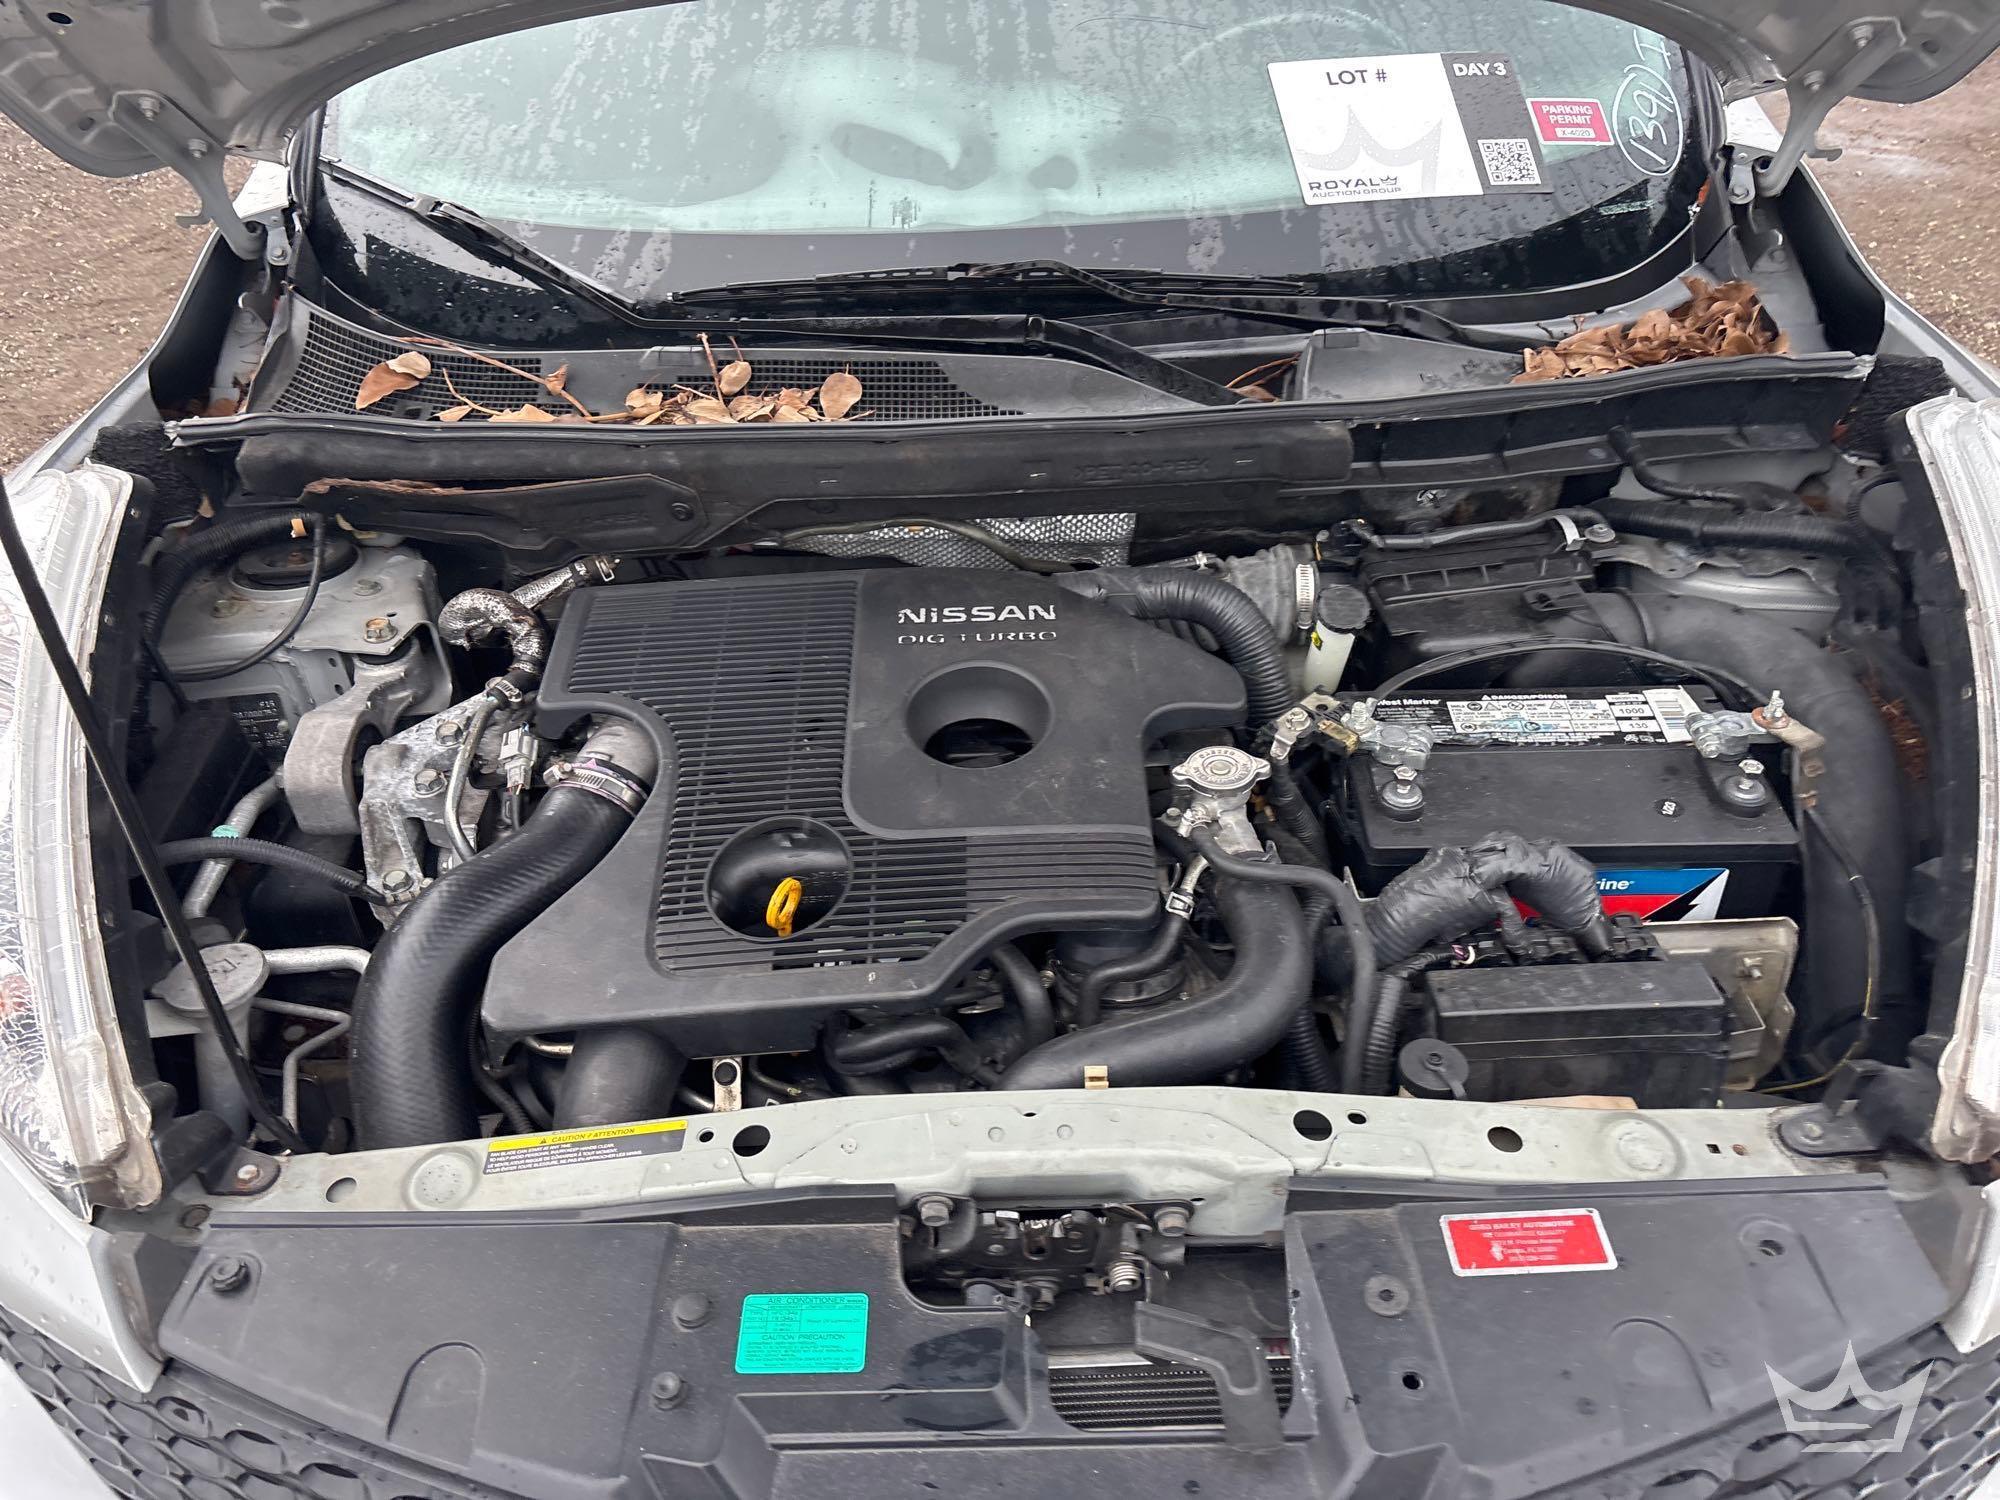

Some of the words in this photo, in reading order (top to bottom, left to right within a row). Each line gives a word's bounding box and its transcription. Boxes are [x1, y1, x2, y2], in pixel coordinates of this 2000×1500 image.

[1453, 63, 1490, 77] DAY
[1493, 62, 1507, 76] 3
[1326, 69, 1367, 86] LOT
[1376, 68, 1387, 83] #
[1541, 105, 1594, 114] PARKING
[1549, 115, 1592, 124] PERMIT
[1308, 178, 1380, 191] ROYAL
[1312, 189, 1361, 198] AUCTION
[1363, 187, 1402, 195] GROUP
[551, 1134, 585, 1142] CAUTION
[593, 1128, 635, 1138] ATTENTION
